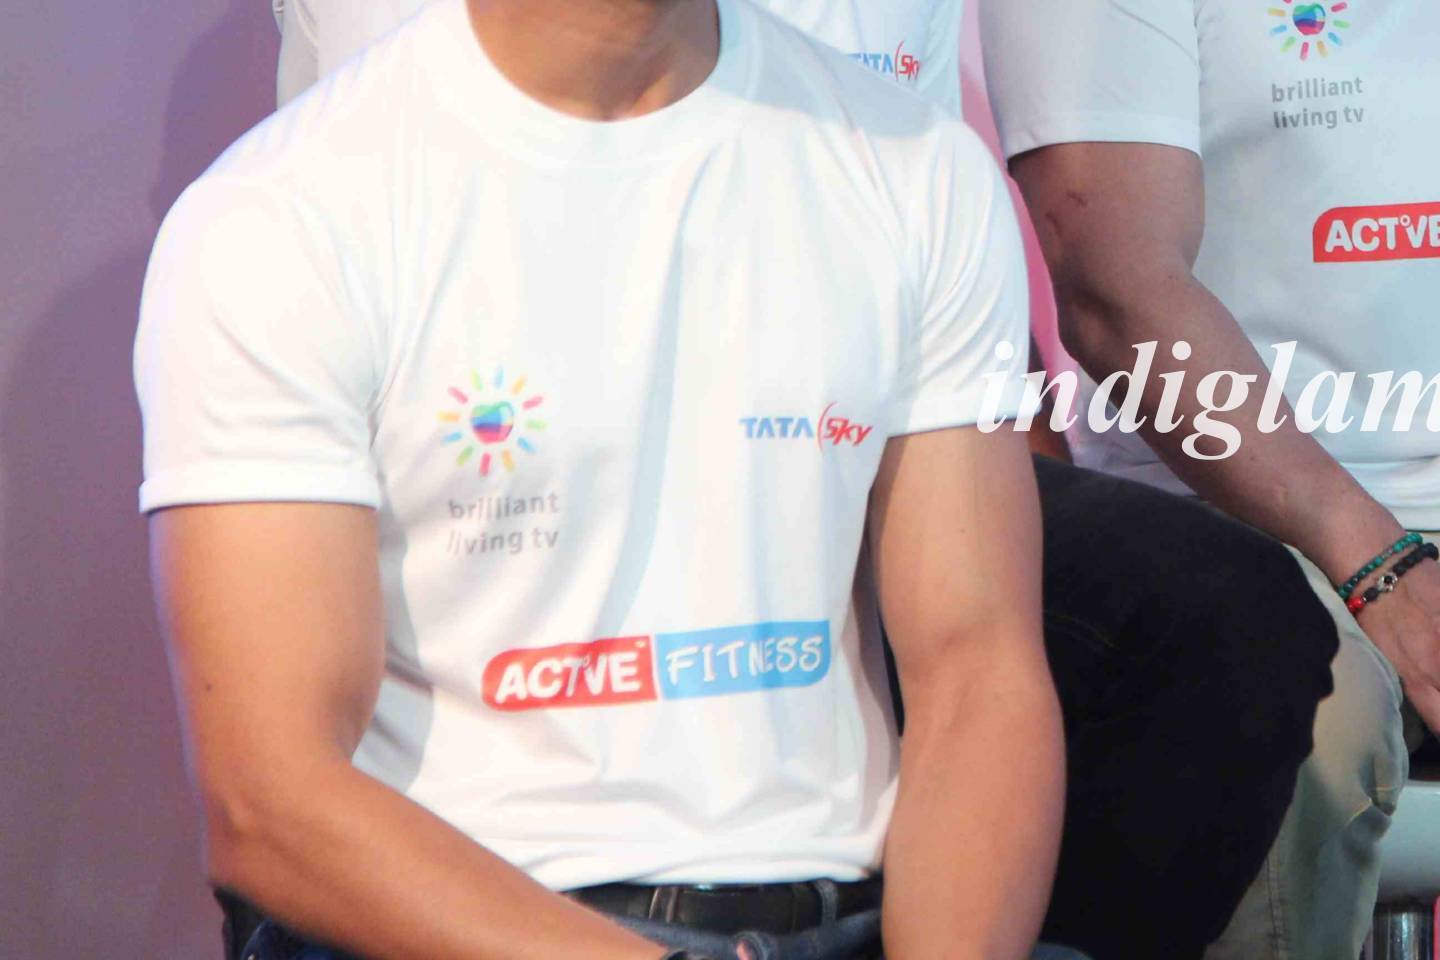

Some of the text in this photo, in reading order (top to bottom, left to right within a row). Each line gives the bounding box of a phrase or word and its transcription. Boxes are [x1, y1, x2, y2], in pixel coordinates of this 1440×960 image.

[1271, 77, 1364, 103] brilliant
[1273, 106, 1364, 130] living tv
[739, 416, 815, 439] TATA
[447, 491, 560, 520] brilliant
[445, 526, 559, 556] living tv
[664, 635, 824, 686] FITNESS
